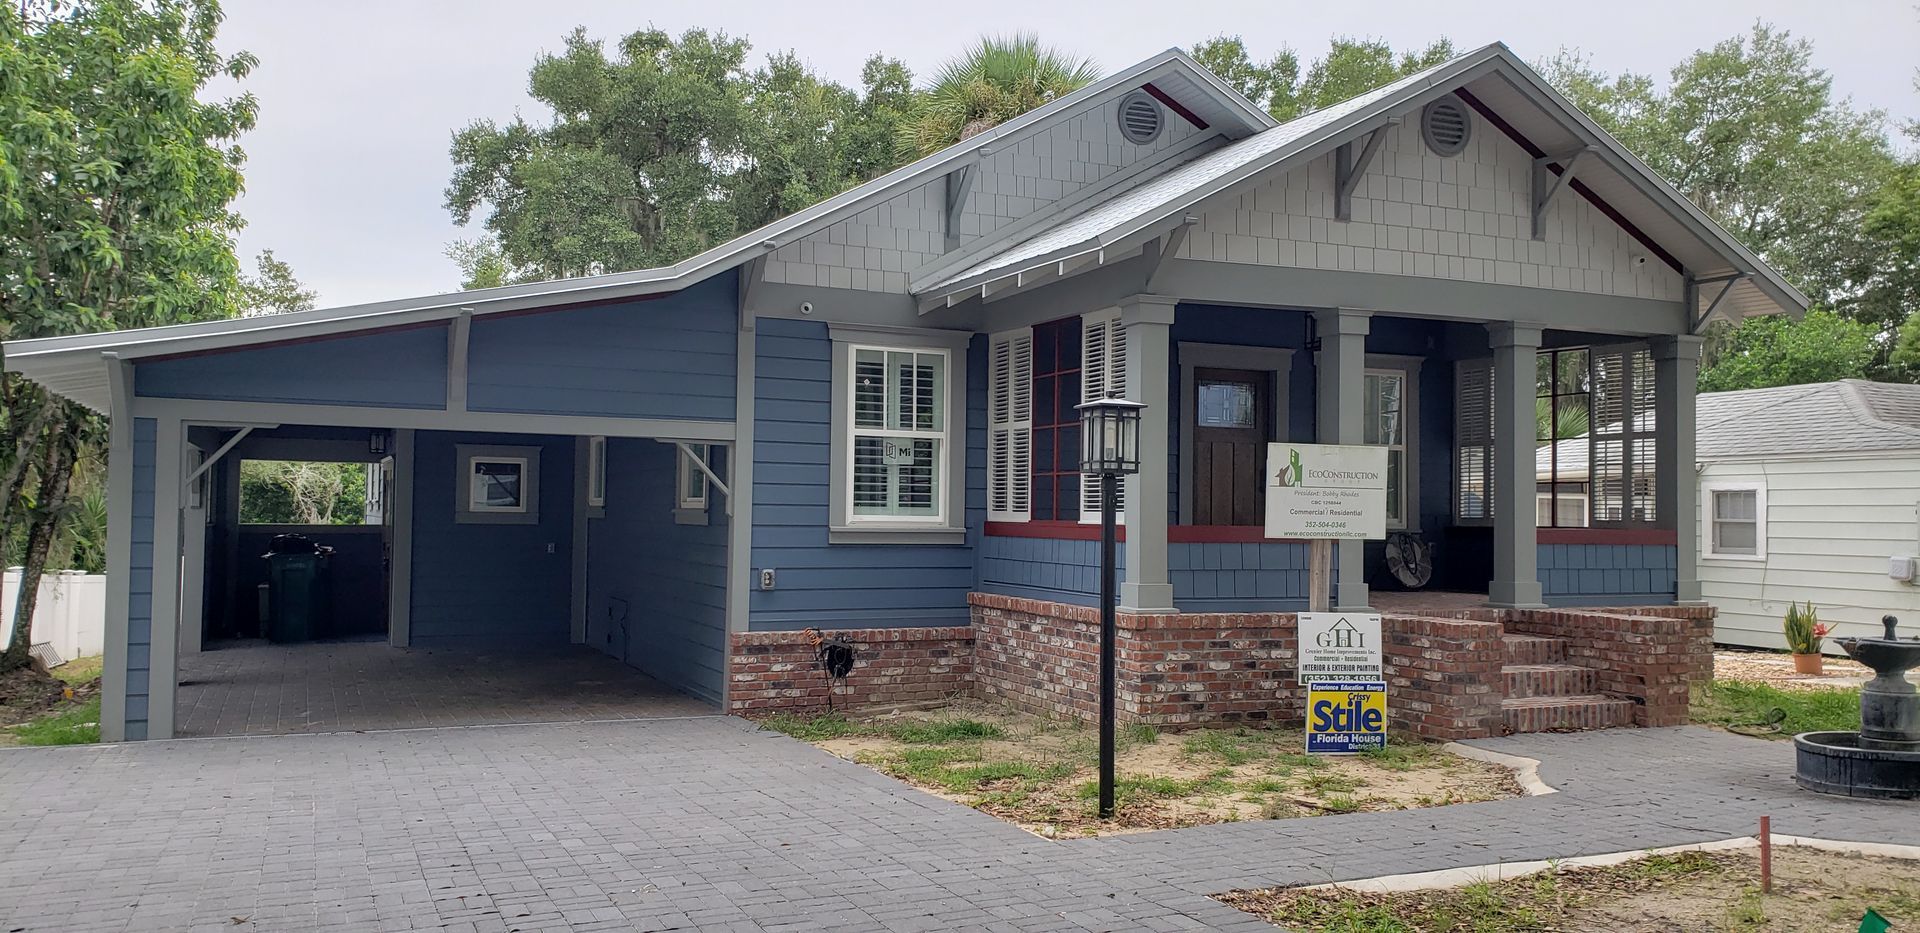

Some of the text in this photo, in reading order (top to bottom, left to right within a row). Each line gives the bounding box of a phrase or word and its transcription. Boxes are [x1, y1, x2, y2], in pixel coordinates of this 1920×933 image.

[899, 447, 911, 457] Mi
[1290, 508, 1325, 516] Commercial
[1305, 521, 1347, 529] 352-504-0346
[1283, 530, 1367, 538] www.ecoconstructionllc.com
[1316, 629, 1366, 648] GHI
[1331, 664, 1356, 672] EXTERIOR
[1356, 664, 1380, 672] PAINTING
[1347, 692, 1371, 703] Crissy
[1313, 700, 1383, 732] Stile
[1317, 733, 1381, 743] Florida House
